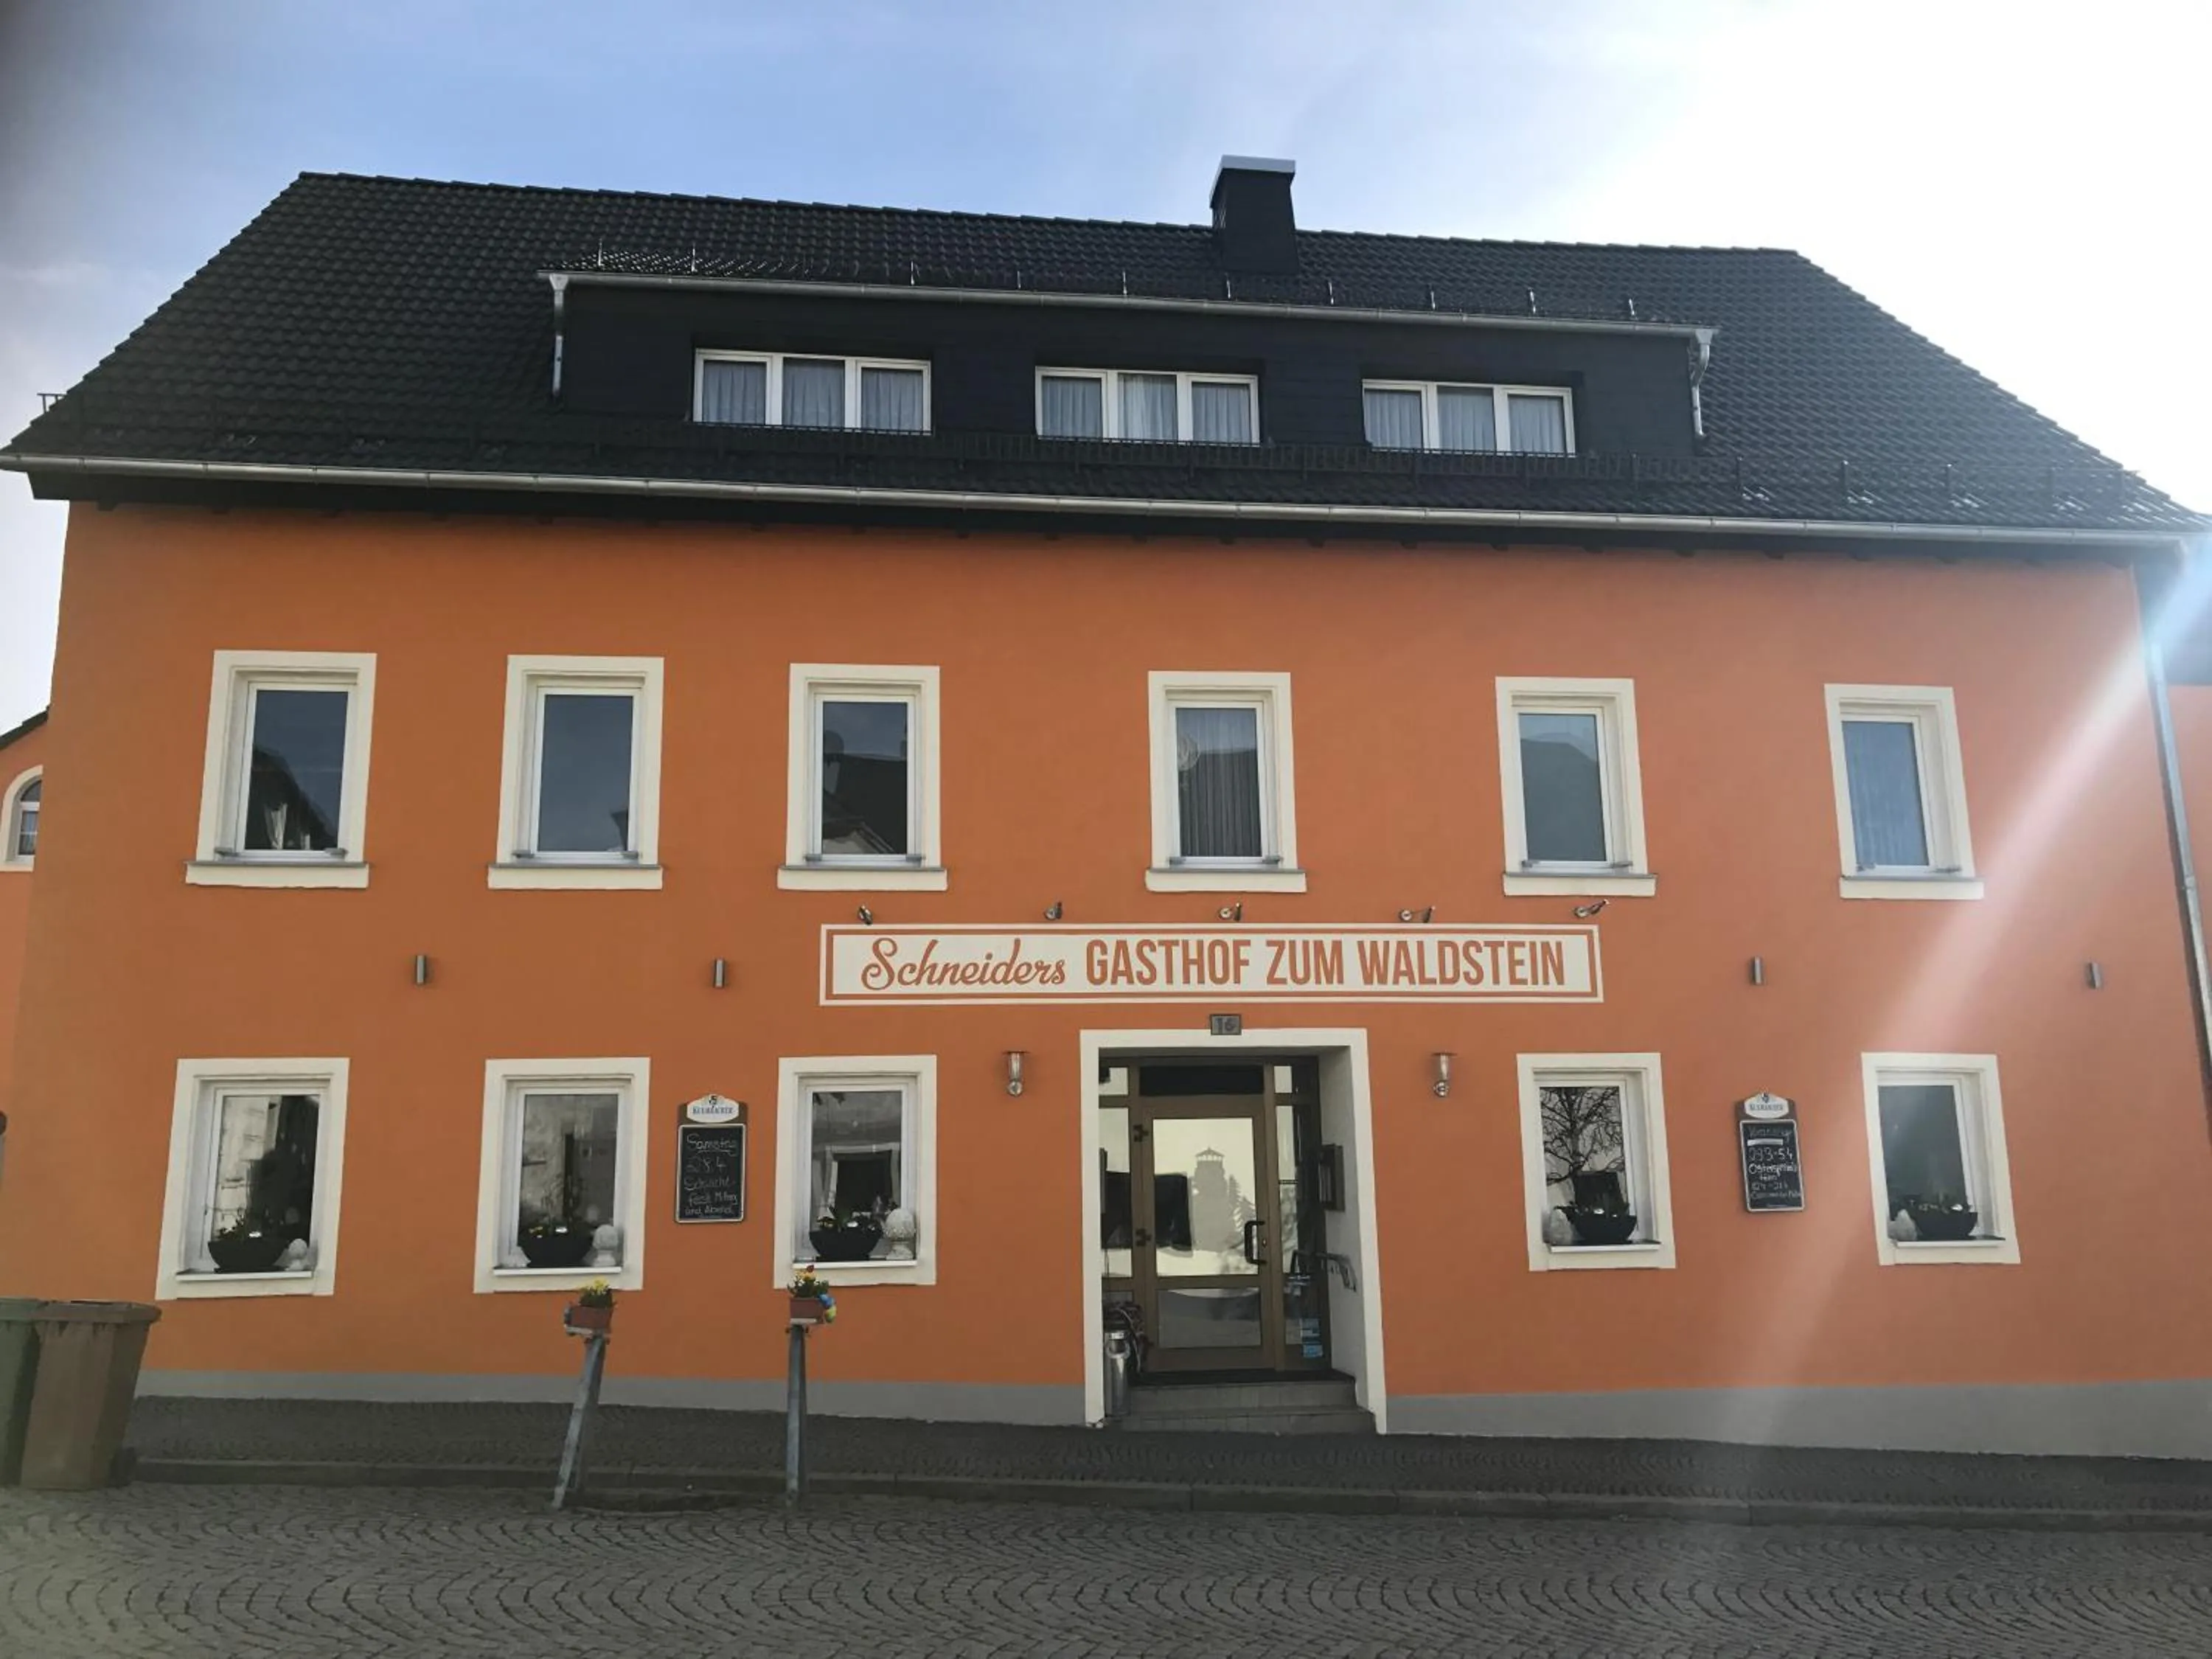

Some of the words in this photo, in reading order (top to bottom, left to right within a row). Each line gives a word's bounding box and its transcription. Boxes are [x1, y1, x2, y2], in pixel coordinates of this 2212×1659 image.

[860, 938, 1065, 990] Schneiders
[1086, 939, 1251, 986] GASTHOF
[1265, 939, 1344, 985] ZUM
[1357, 940, 1565, 986] WALDSTEIN
[1215, 1018, 1237, 1033] 16
